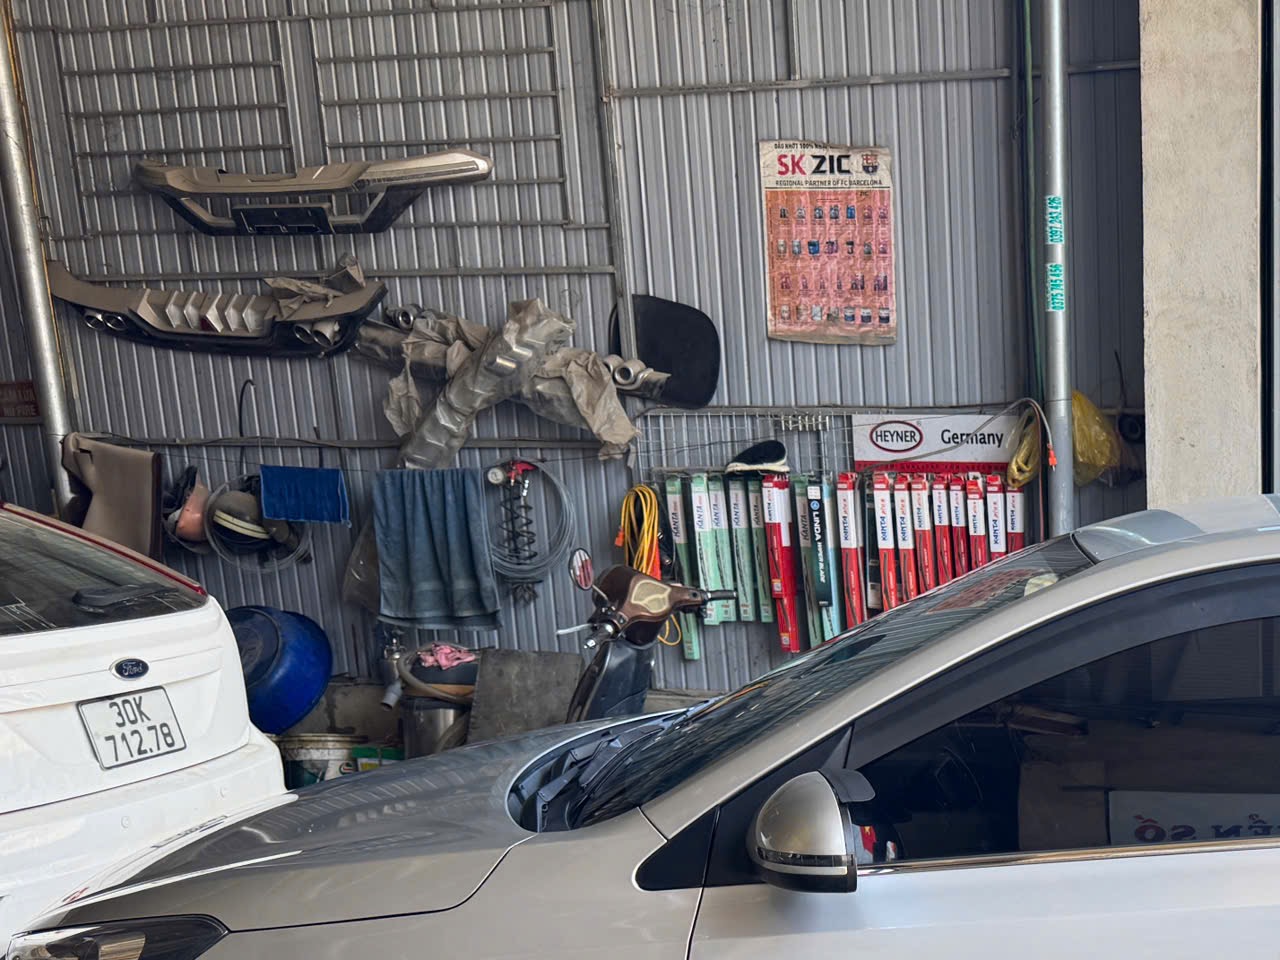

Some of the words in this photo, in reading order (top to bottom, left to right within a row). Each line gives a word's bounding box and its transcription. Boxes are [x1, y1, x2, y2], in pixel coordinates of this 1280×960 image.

[777, 154, 807, 176] SK
[811, 154, 852, 175] ZIC
[775, 179, 804, 187] REGIONAL
[805, 179, 831, 187] PARTNER
[832, 179, 841, 187] OF
[849, 179, 883, 187] BARCELONA
[875, 430, 918, 443] HEYNER
[940, 429, 1004, 449] Germany
[672, 512, 682, 538] KANTA
[695, 505, 704, 530] KANTA
[712, 503, 721, 527] KANTA
[733, 502, 741, 527] KANTA
[801, 513, 811, 541] KANTA
[812, 511, 823, 542] LINDA
[879, 515, 888, 542] KANTA
[899, 515, 908, 542] KANTA
[817, 541, 825, 562] WIPER
[819, 562, 827, 584] BLADE
[121, 661, 144, 677] Ford
[108, 695, 151, 728] 30K
[104, 722, 176, 763] 712.78
